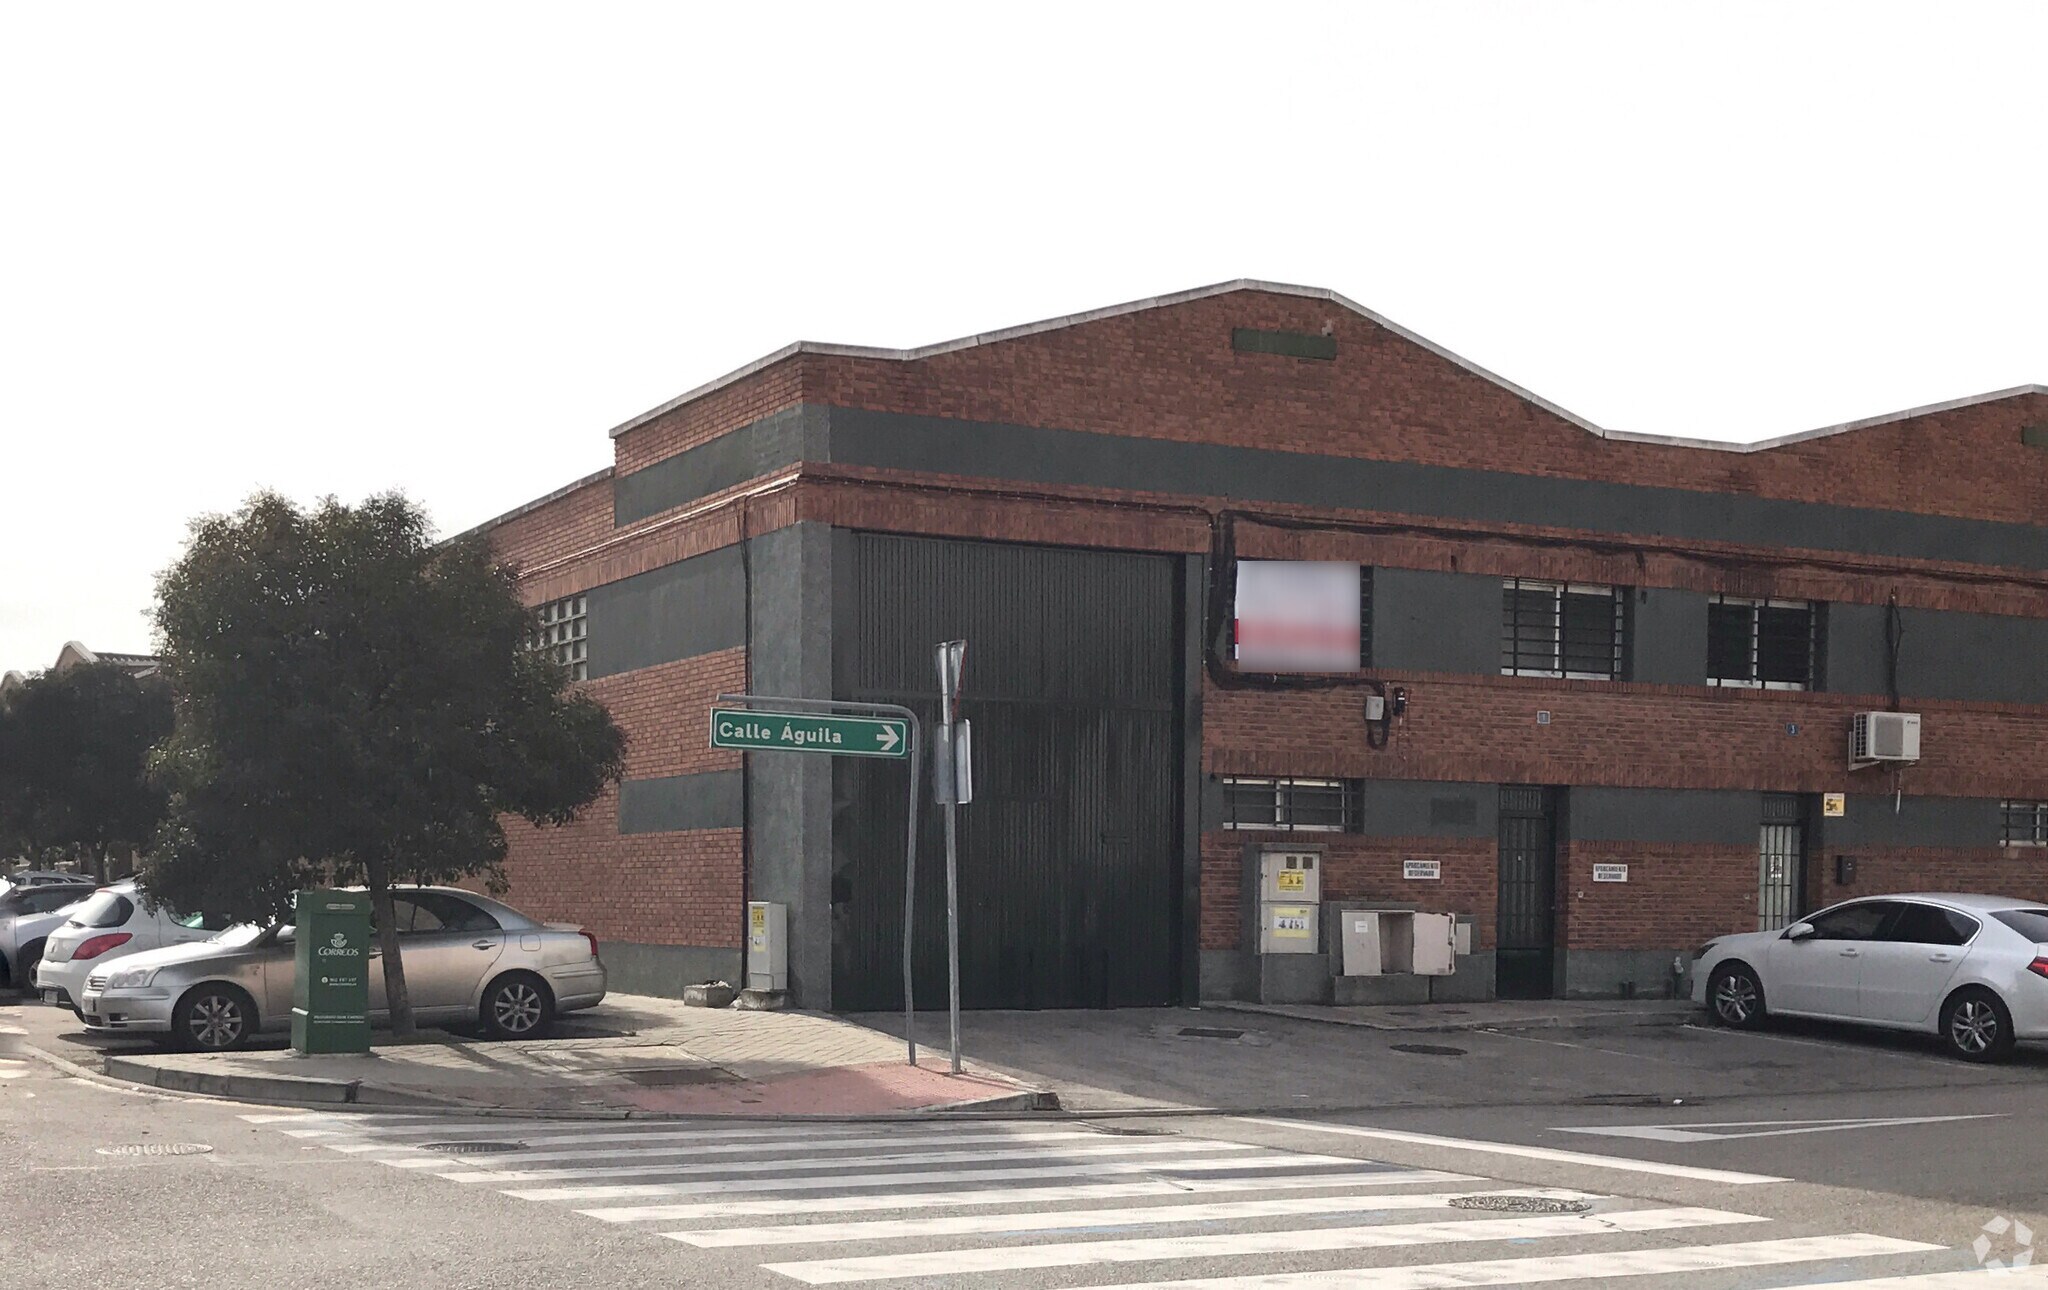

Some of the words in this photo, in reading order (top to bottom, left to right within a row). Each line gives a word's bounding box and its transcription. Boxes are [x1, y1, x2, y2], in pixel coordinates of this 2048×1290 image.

[719, 721, 772, 740] Calle
[780, 721, 843, 745] Águila
[318, 946, 359, 957] CORREOS
